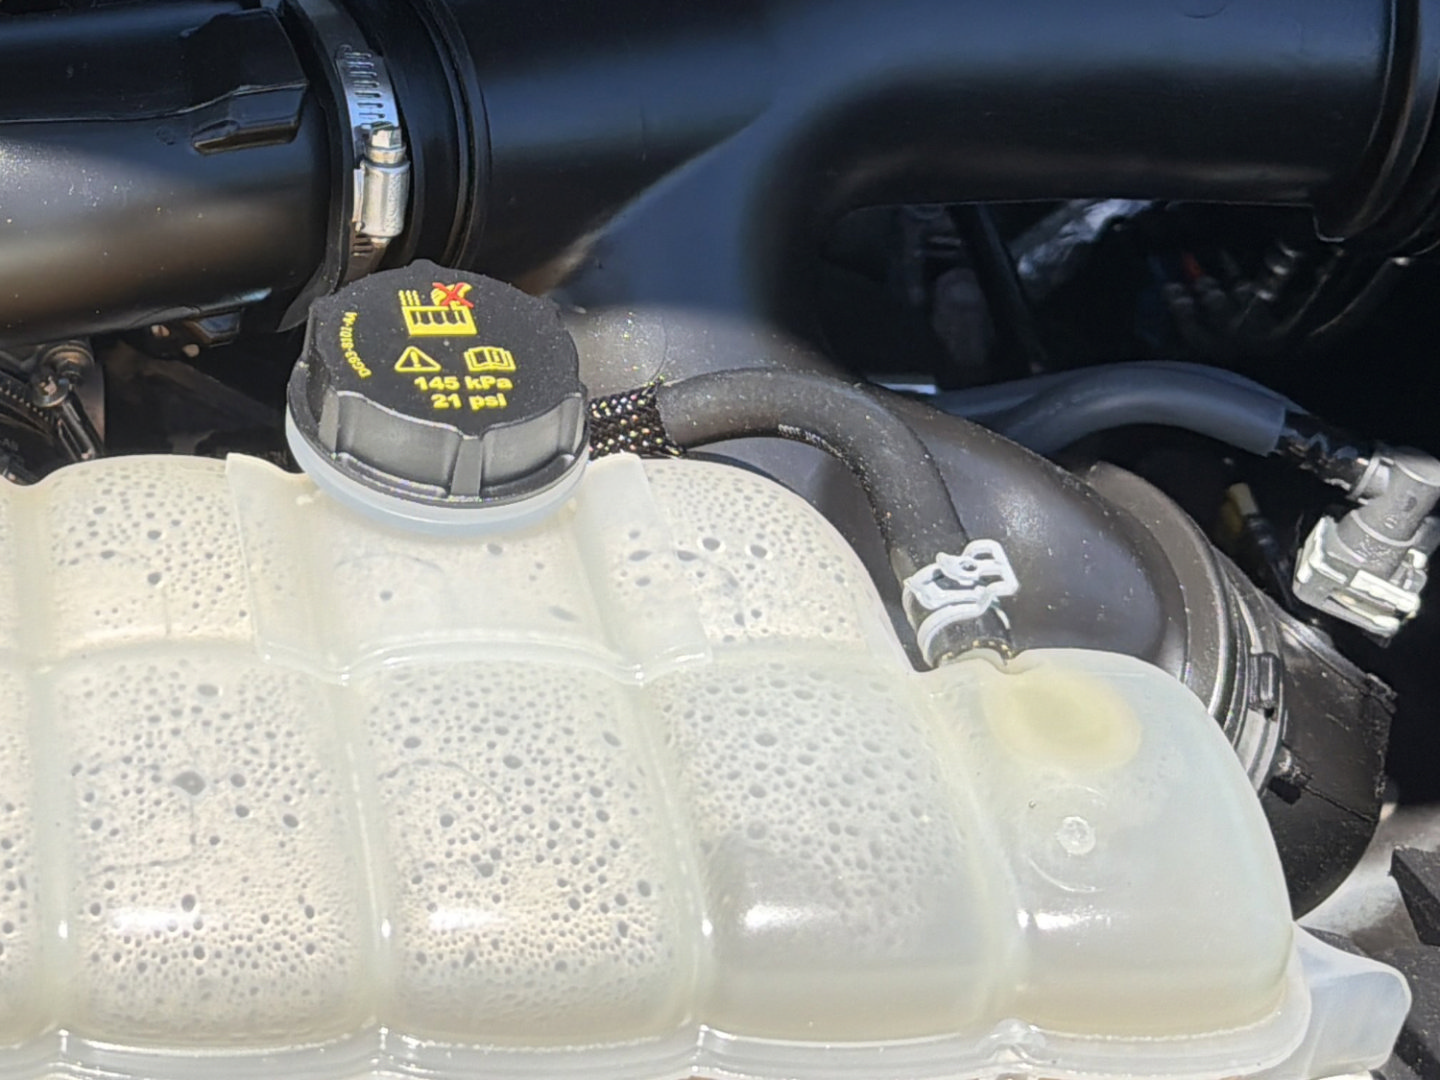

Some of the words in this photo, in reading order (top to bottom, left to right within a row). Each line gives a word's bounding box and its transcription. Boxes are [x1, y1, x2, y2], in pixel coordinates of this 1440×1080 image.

[414, 376, 460, 391] 145
[464, 375, 513, 390] kPa
[431, 394, 462, 409] 21
[468, 394, 507, 411] psi
